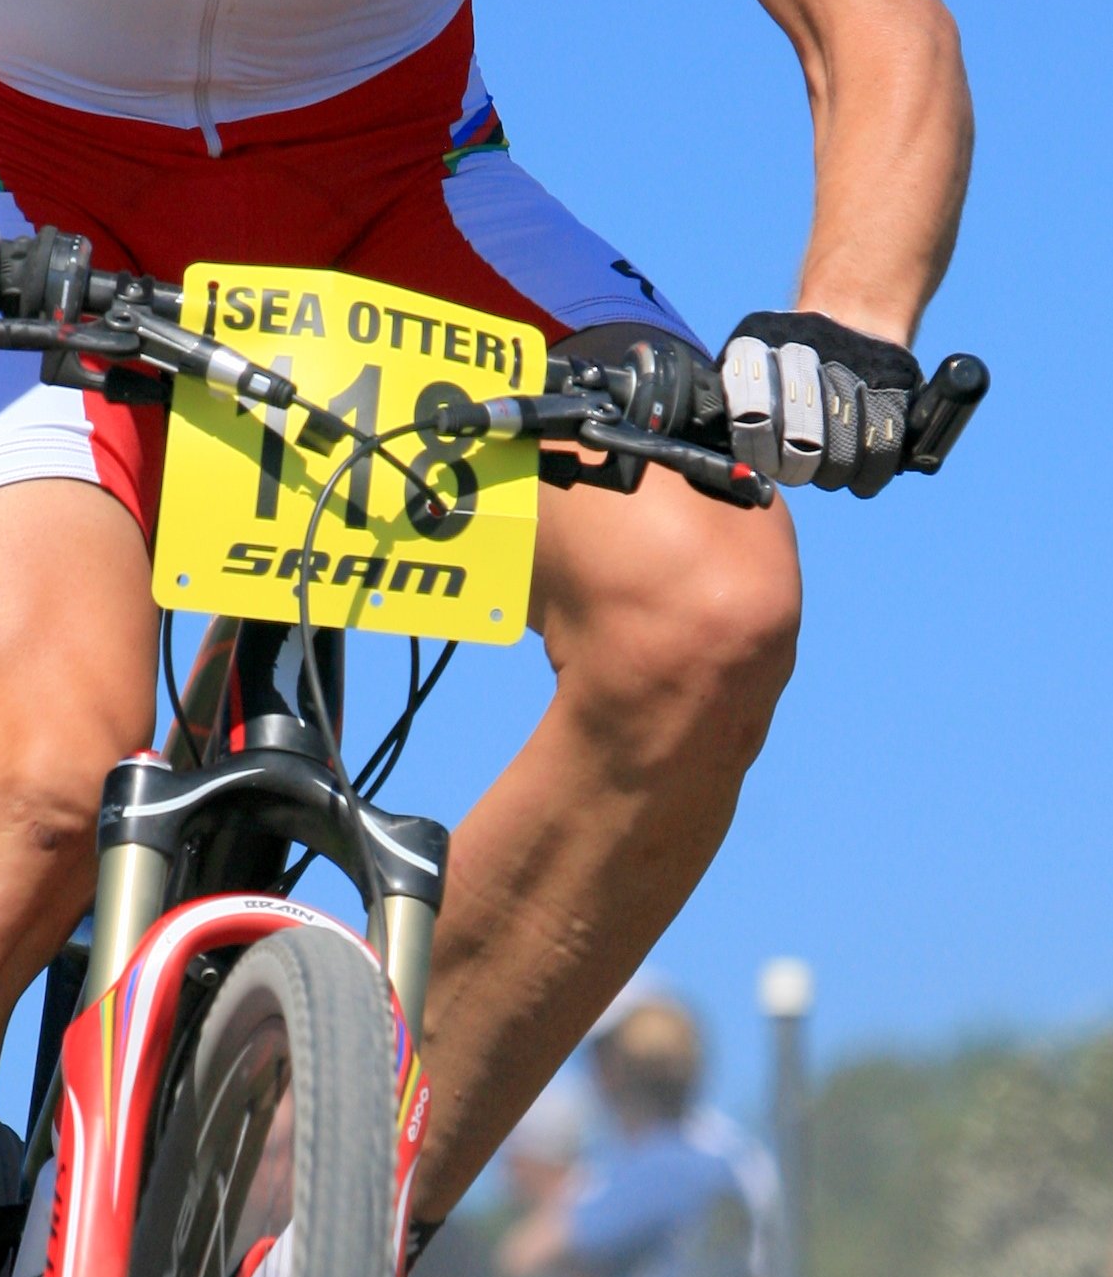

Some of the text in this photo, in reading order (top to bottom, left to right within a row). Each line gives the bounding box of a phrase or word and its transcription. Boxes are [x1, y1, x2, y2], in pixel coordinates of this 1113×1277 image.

[222, 286, 506, 374] SEA OTTER
[236, 355, 478, 541] 118
[221, 542, 467, 598] SRAM
[244, 900, 315, 922] BRAIN
